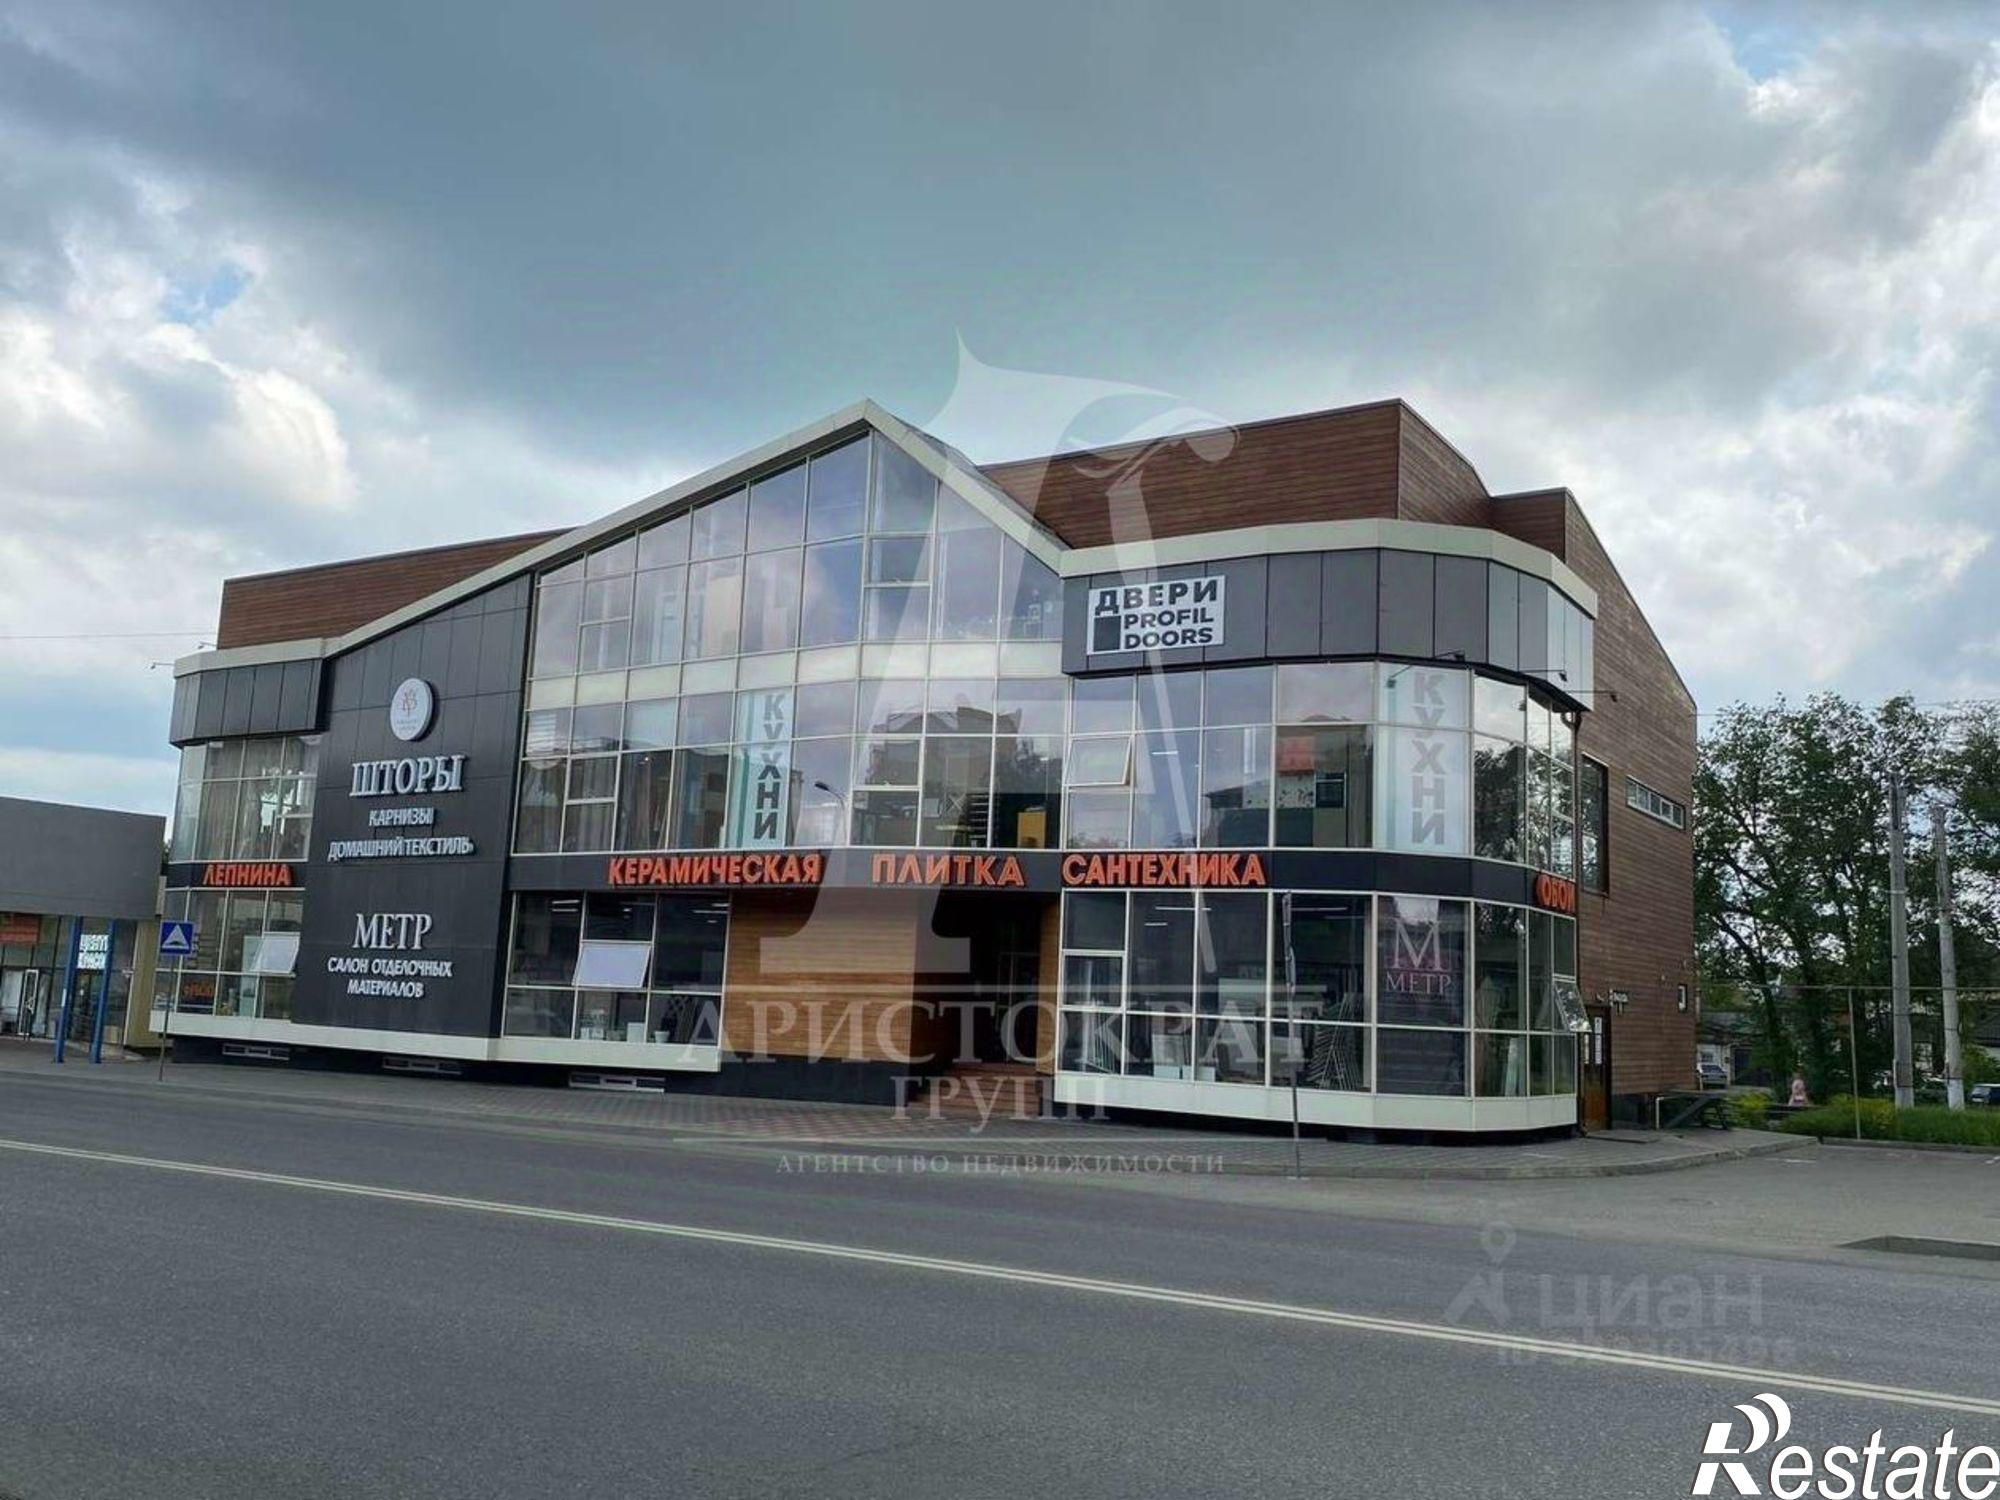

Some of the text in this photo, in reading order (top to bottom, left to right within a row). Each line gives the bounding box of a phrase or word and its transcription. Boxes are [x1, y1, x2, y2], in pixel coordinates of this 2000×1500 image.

[1094, 579, 1218, 616] ДВЕРИ
[1124, 607, 1214, 629] PROFIL
[1124, 627, 1213, 649] DOORS
[753, 694, 785, 840] КУХНИ
[1411, 672, 1446, 846] КУХНИ
[349, 755, 466, 796] ШТОРЫ
[369, 807, 435, 827] КАРНИЗЫ
[327, 836, 474, 862] ДОМАШНИЙ ТЕКСТИЛЬ
[202, 863, 293, 886] ЛЕПНИНА
[607, 852, 1268, 887] КЕРАМИЧЕСКАЯ ПЛИТКА САНТЕХНИКА
[352, 913, 433, 950] МЕТР
[327, 957, 453, 977] САЛОН ОТДЕЛОЧНЫХ
[347, 980, 424, 998] МАТЕРИАЛОВ
[1385, 970, 1452, 995] МЕТР
